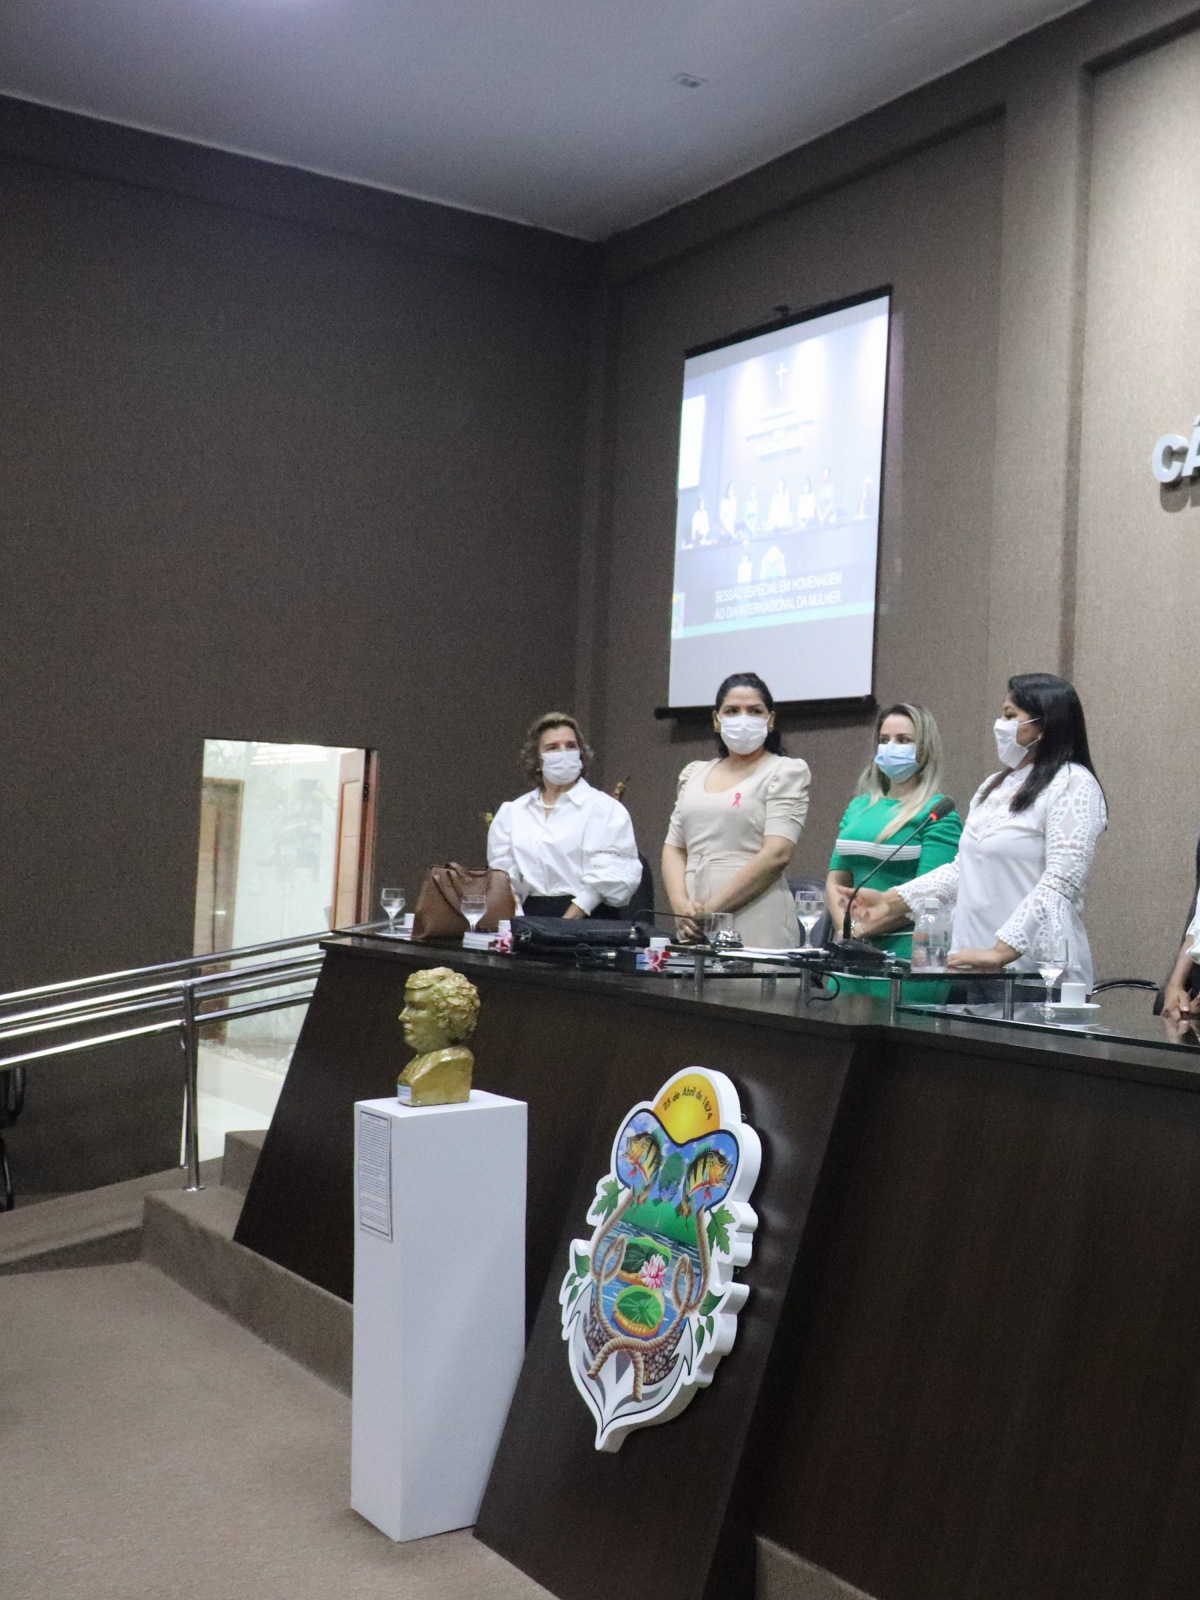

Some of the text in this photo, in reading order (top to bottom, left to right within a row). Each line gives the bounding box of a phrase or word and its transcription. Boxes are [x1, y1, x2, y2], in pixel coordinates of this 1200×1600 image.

[714, 571, 842, 603] SESSÃO ESPECIAL EM HOMENAGEM
[714, 590, 841, 620] AO DIA INTERNACIONAL DA MULHER
[673, 1091, 680, 1102] de
[682, 1086, 696, 1097] Abril
[696, 1090, 702, 1101] de
[702, 1096, 712, 1120] 1874
